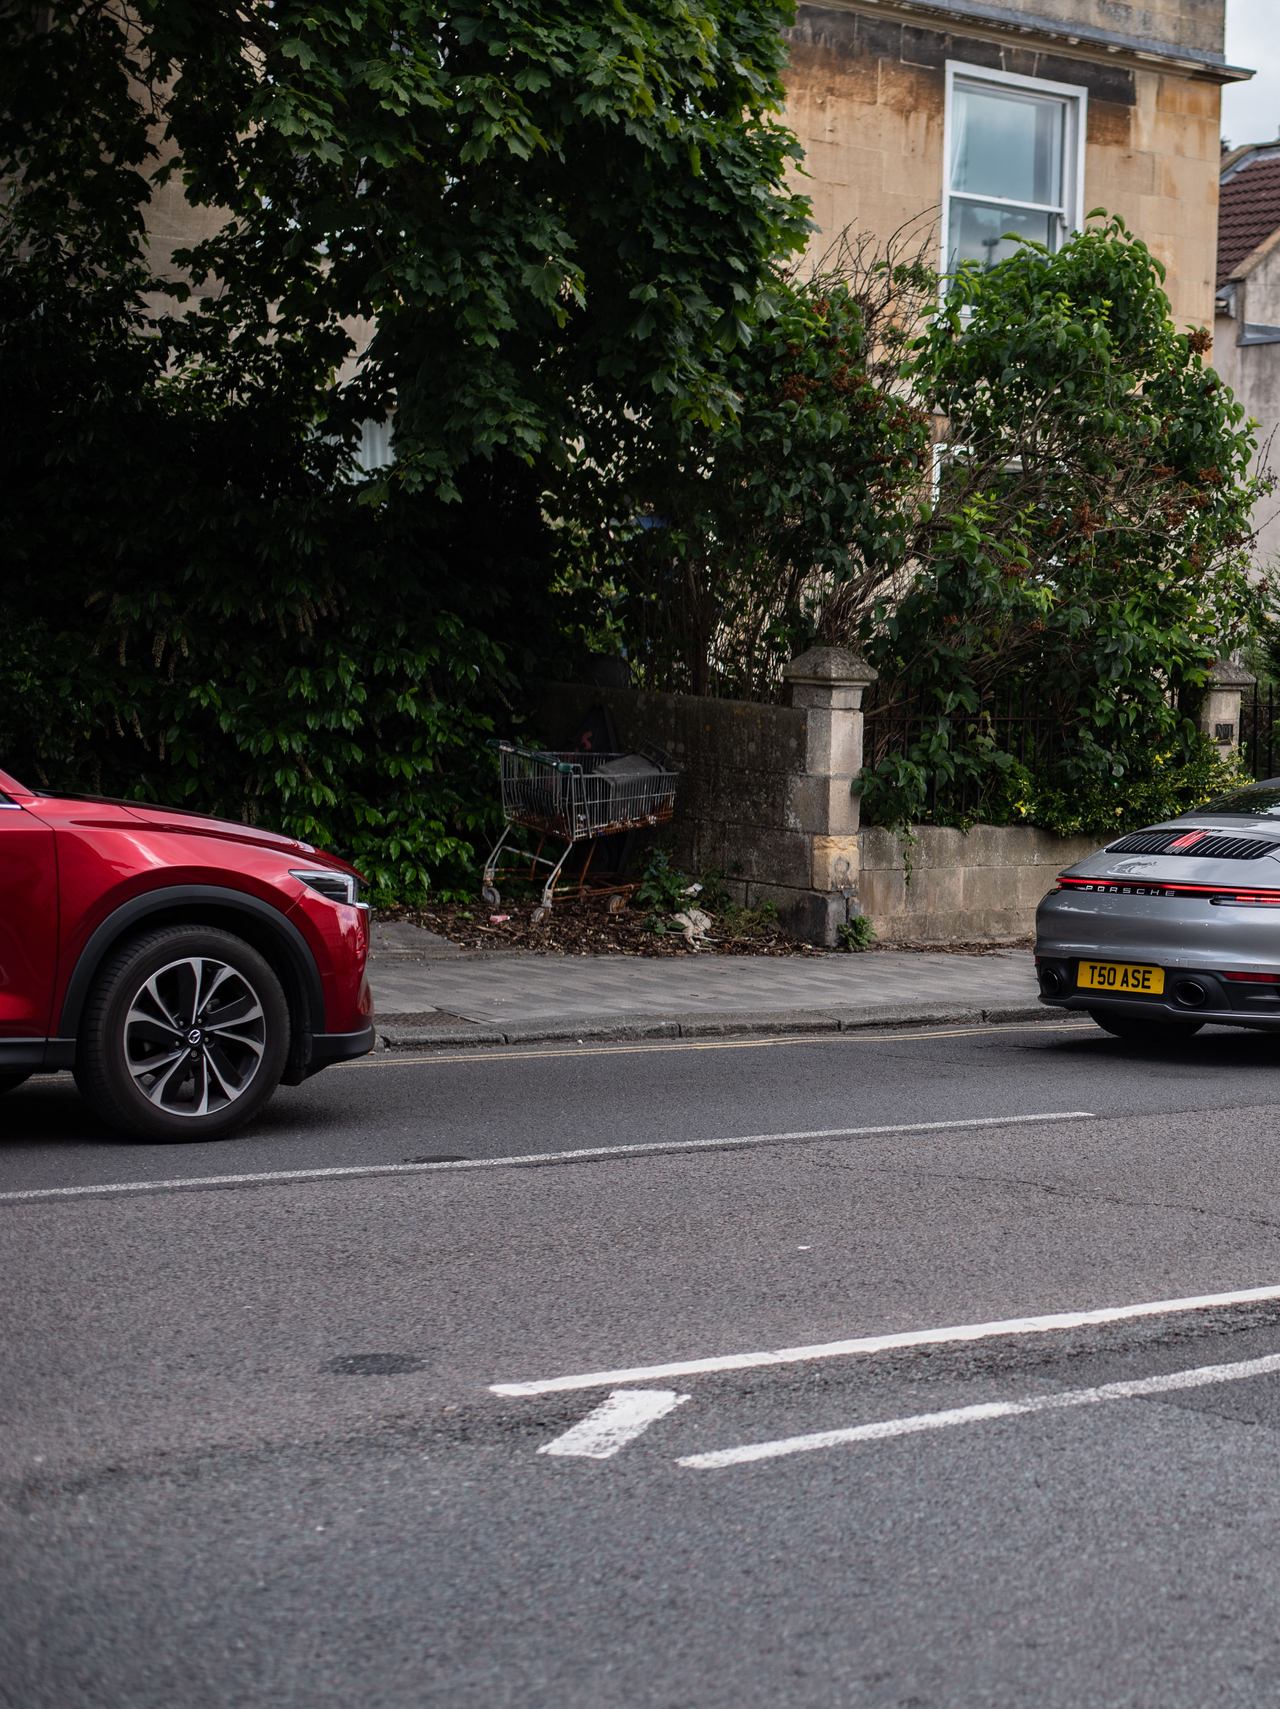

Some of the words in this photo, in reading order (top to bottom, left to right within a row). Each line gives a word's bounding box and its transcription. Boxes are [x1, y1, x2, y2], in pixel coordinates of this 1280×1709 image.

[1085, 885, 1175, 897] PORSCHE
[1089, 965, 1117, 986] T50
[1120, 968, 1152, 989] ASE
